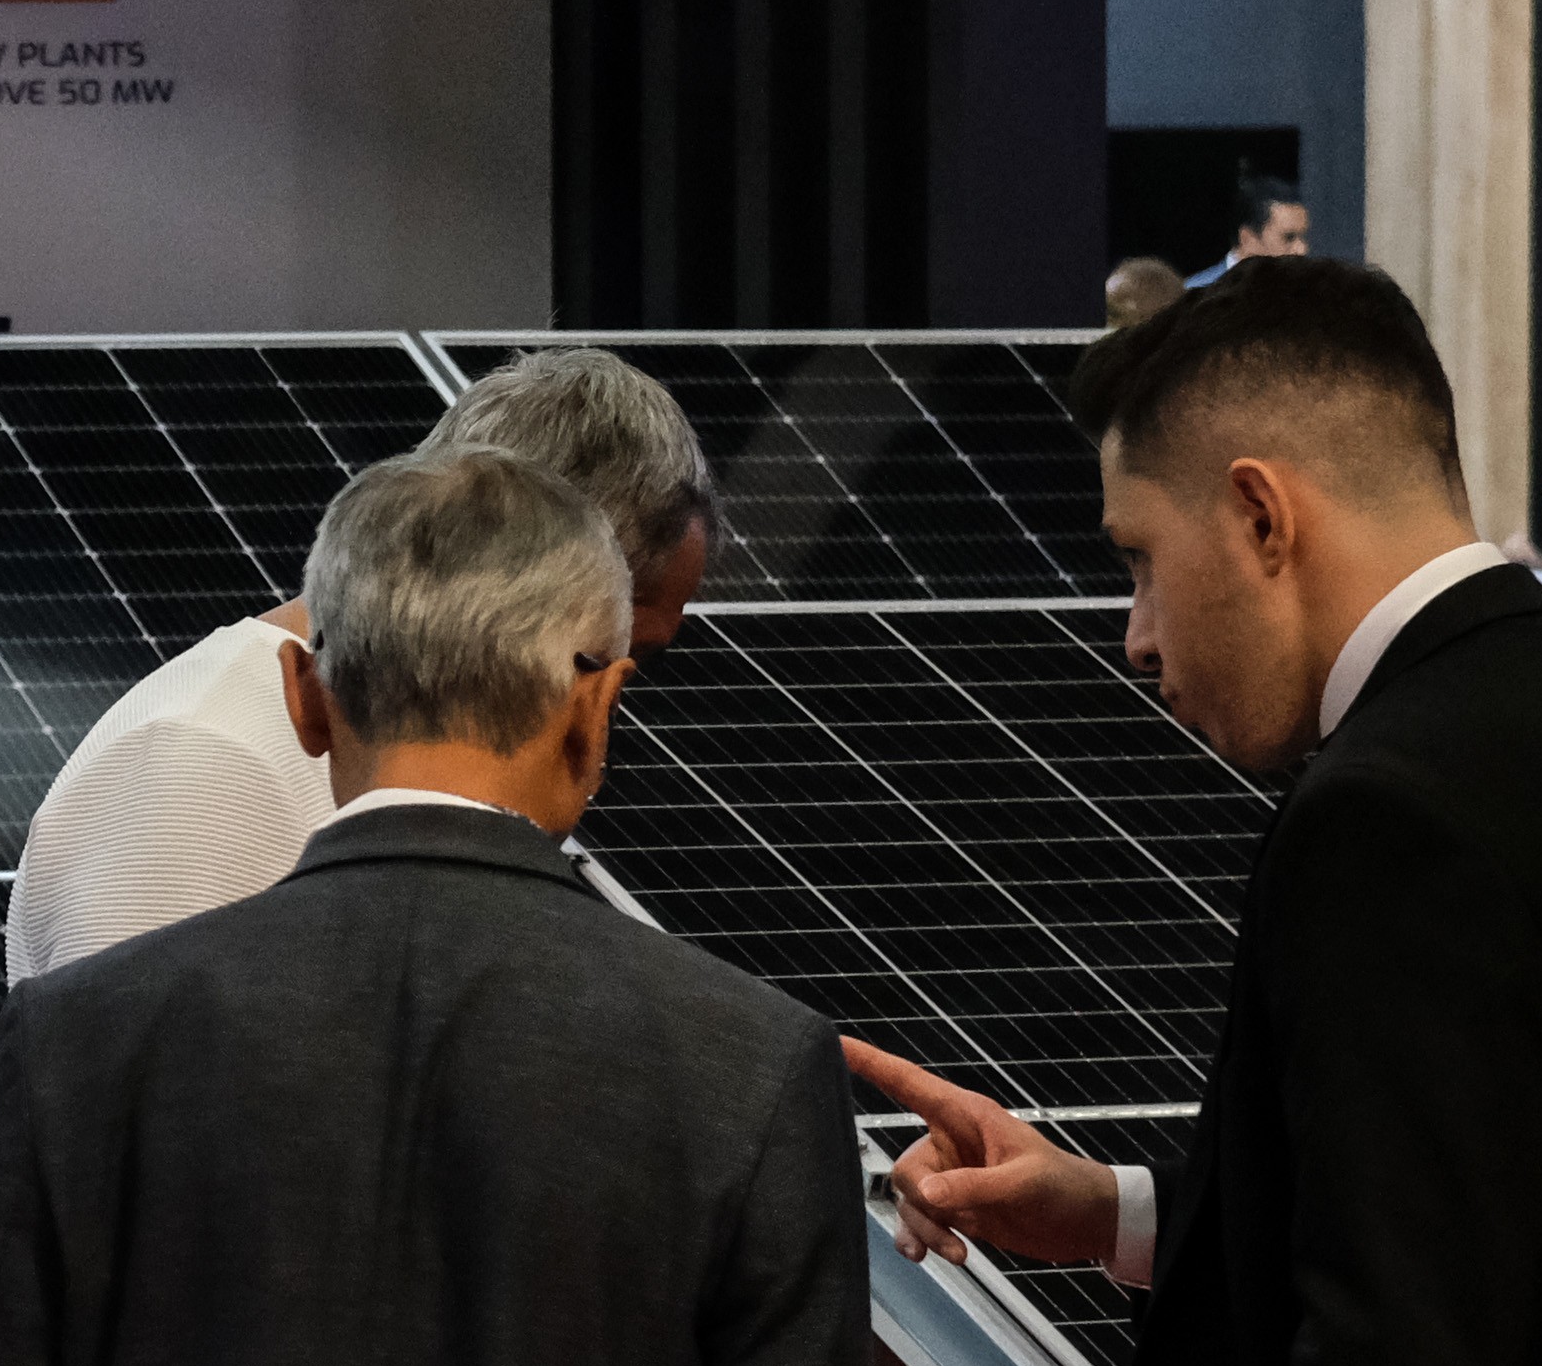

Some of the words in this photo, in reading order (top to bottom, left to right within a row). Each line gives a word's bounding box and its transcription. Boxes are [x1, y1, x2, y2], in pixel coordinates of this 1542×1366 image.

[17, 40, 146, 68] PLANTS
[58, 78, 102, 106] 50
[112, 78, 175, 105] MW
